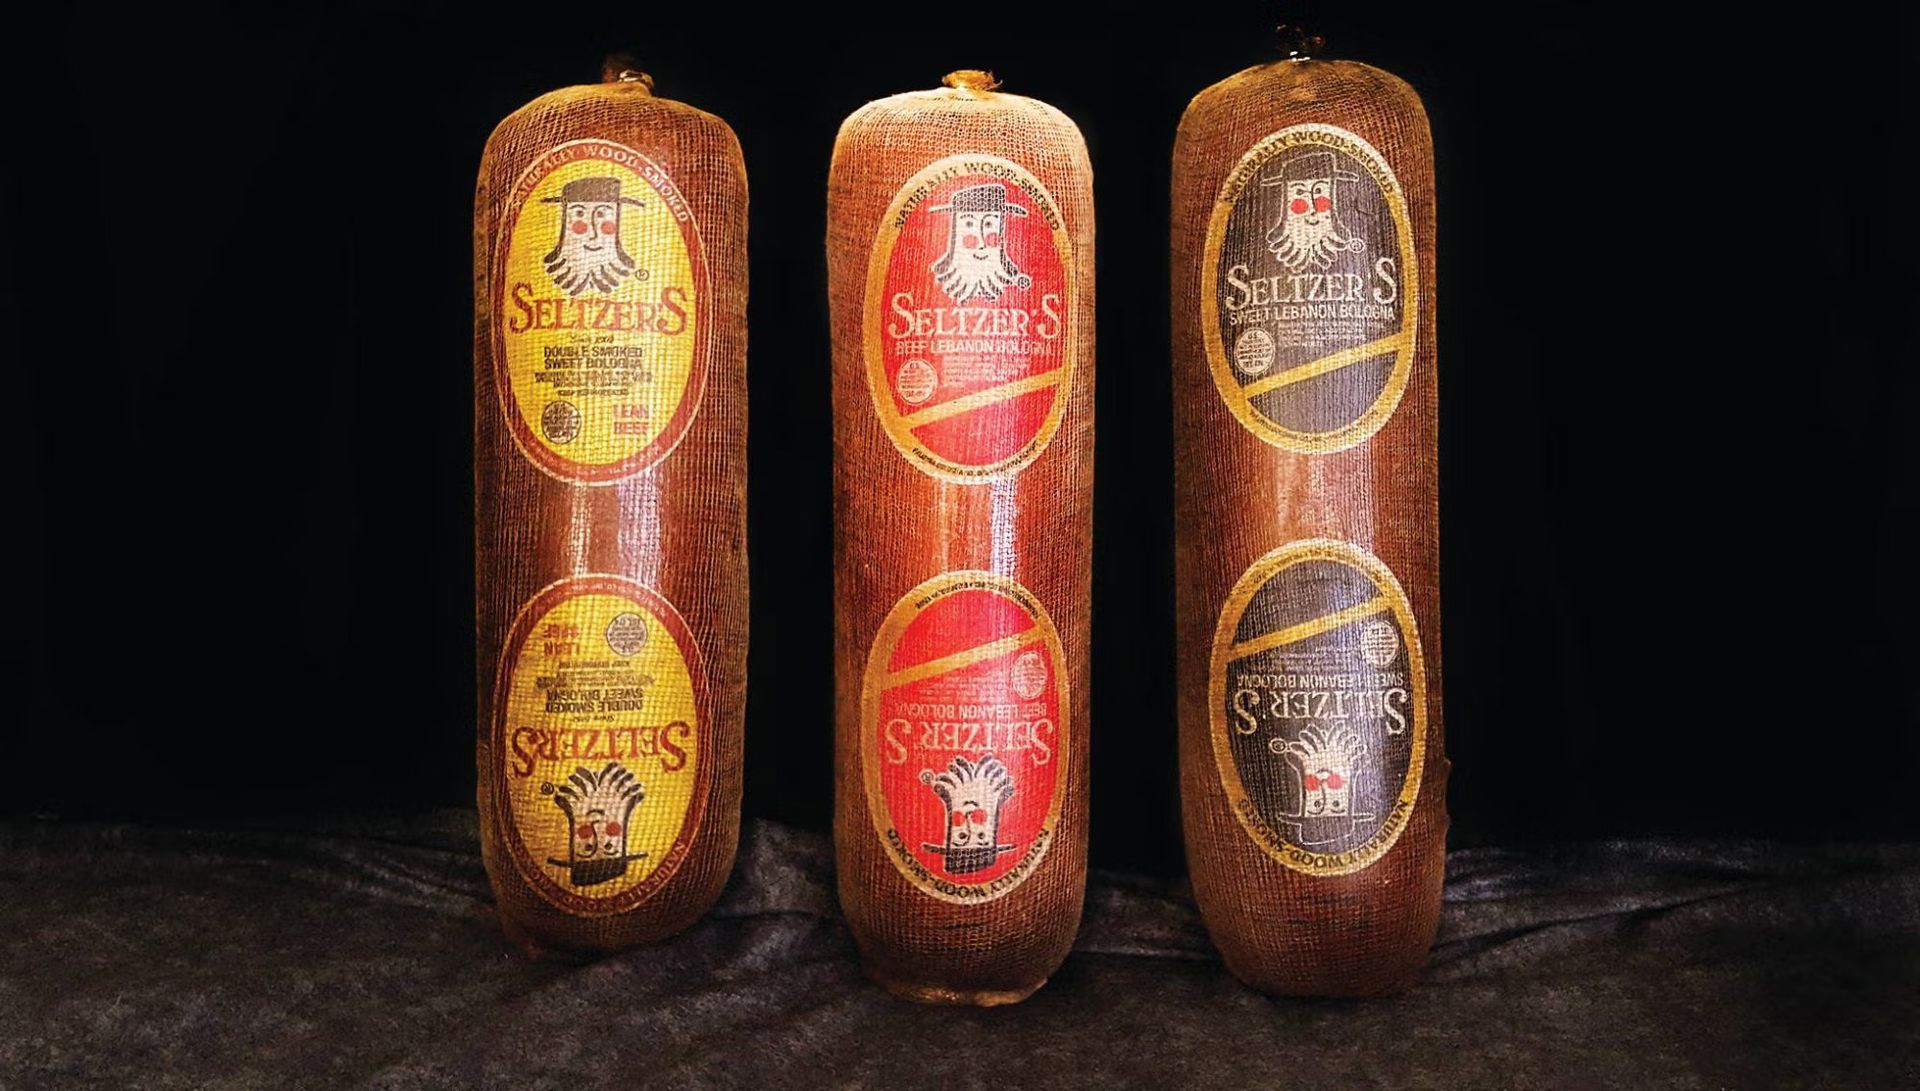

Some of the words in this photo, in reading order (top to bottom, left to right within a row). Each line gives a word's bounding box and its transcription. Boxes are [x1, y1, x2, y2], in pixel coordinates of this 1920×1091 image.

[1225, 257, 1397, 310] SELTZER'S
[888, 292, 1061, 339] SELTZER'S
[1230, 308, 1272, 325] SWEET
[1275, 305, 1336, 321] LEBANON
[1341, 303, 1395, 321] BOLOGNA
[544, 346, 589, 357] DOUBLE
[592, 346, 642, 357] SMOKED
[896, 341, 928, 354] BEEF
[930, 340, 994, 354] LEBANON
[997, 340, 1055, 355] BOLOGNA
[544, 358, 583, 370] SWEET
[586, 358, 642, 370] BOLOGNA
[1237, 673, 1296, 688] BOLOGNA
[546, 689, 600, 702] BOLOGNA
[603, 688, 644, 700] SWEET
[545, 702, 594, 713] SMOKED
[598, 700, 643, 711] DOUBLE
[894, 703, 955, 718] BOLOGNA
[959, 704, 1018, 718] LEBANON
[1022, 702, 1046, 717] BEEF
[1233, 688, 1407, 736] SELTZER'S
[1239, 799, 1344, 867] WOOD-SMOKED
[1347, 800, 1409, 862] NATURALLY
